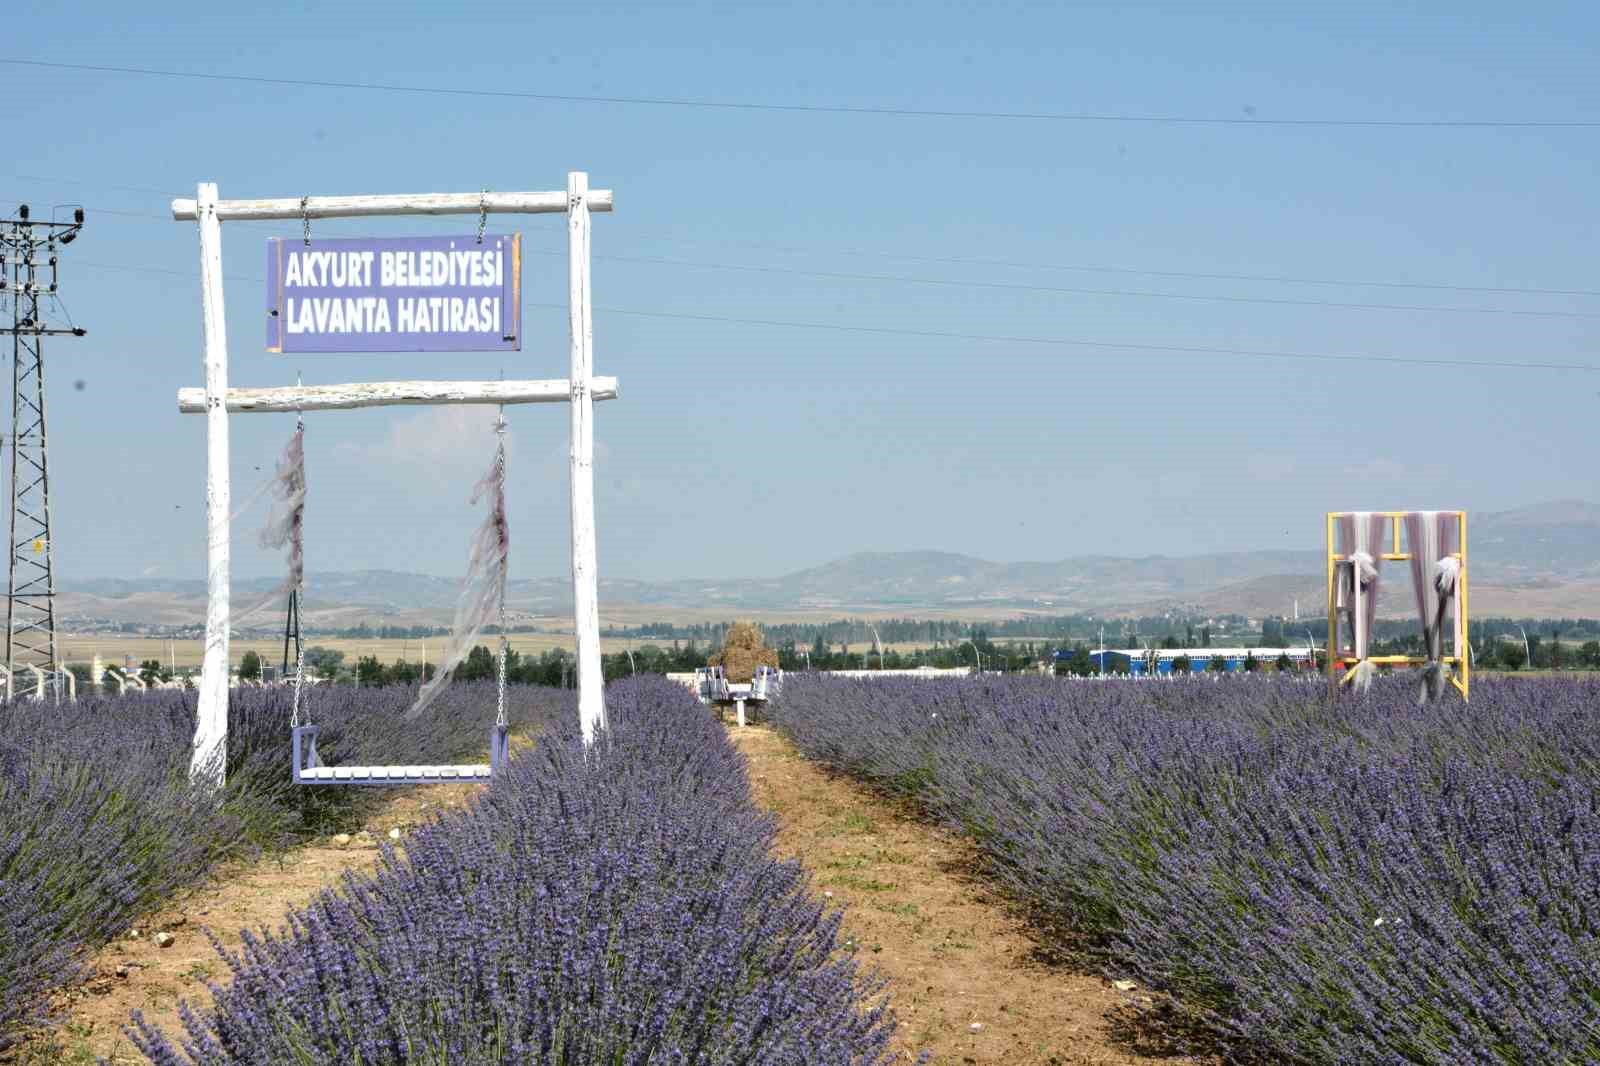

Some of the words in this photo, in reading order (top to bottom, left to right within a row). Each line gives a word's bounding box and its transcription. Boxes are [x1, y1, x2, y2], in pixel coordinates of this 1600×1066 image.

[285, 251, 374, 287] AKYURT
[380, 241, 503, 286] BELEDİYESİ
[287, 298, 391, 333] LAVANTA
[397, 297, 499, 332] HATIRASI
